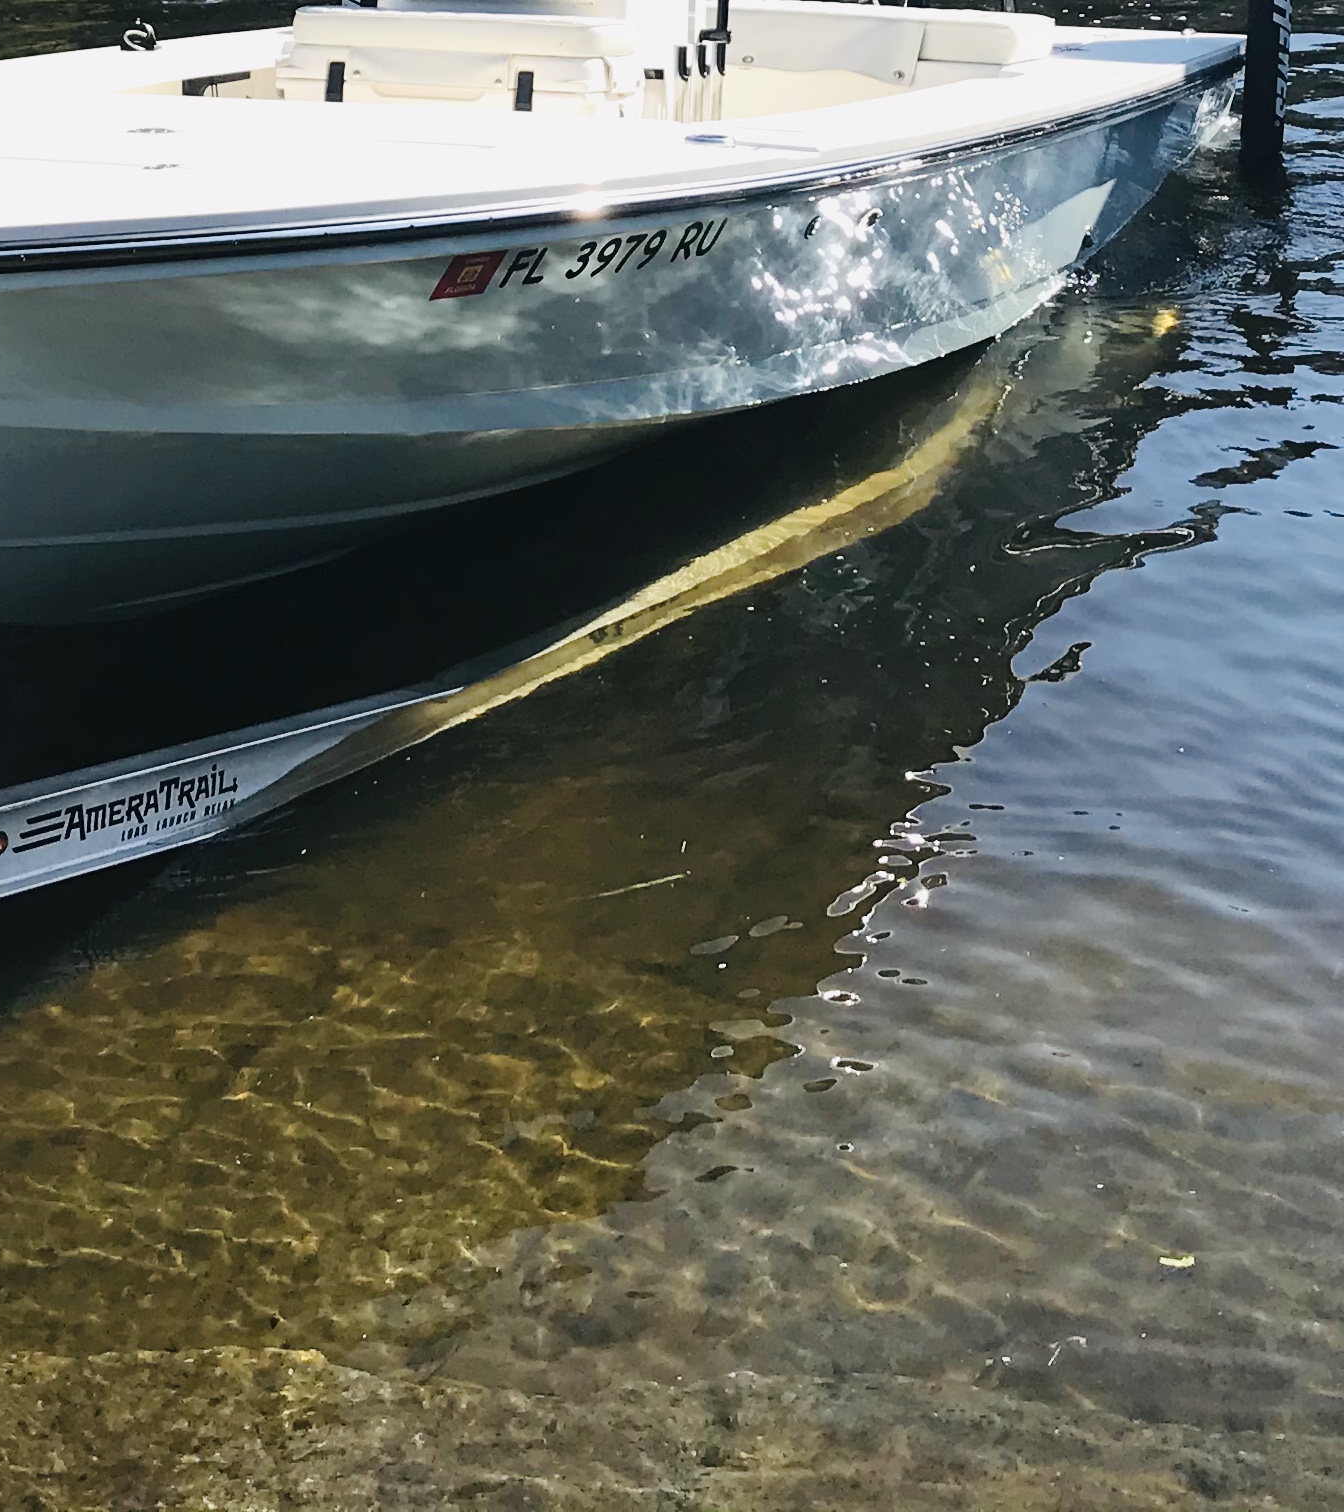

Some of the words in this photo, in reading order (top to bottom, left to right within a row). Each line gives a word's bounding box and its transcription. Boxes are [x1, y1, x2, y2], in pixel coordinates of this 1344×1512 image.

[499, 247, 548, 288] FL
[565, 229, 668, 280] 3979
[670, 217, 729, 263] RU
[121, 823, 148, 842] LOAD
[156, 809, 197, 832] LAUNCH
